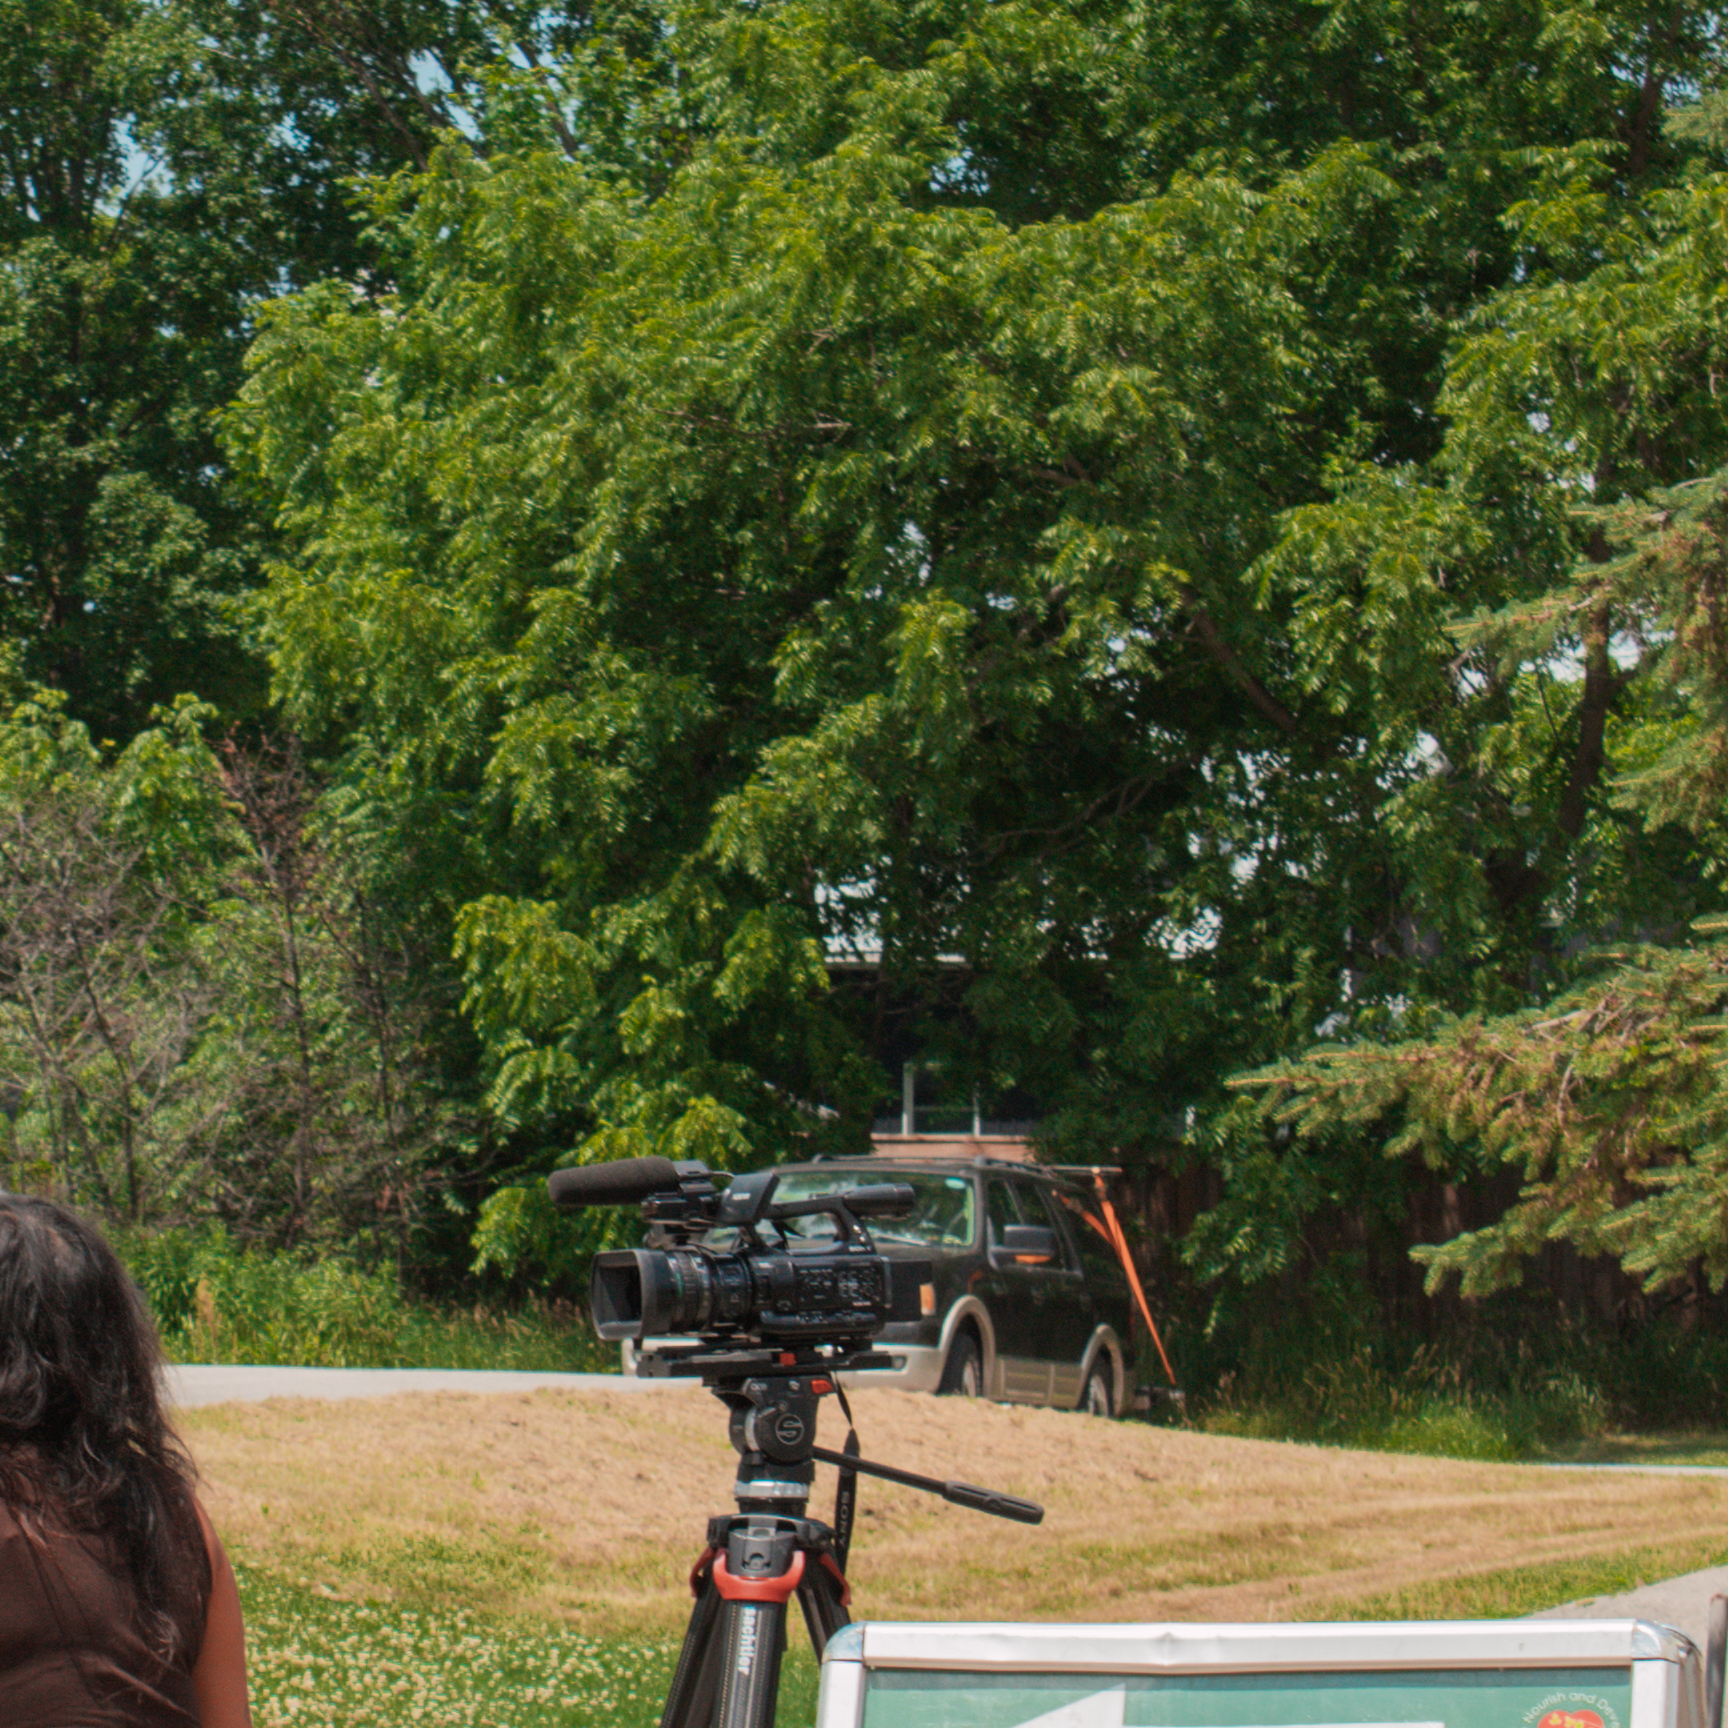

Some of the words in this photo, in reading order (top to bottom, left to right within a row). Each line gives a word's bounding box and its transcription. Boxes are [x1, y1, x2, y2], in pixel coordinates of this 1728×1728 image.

[840, 1491, 851, 1544] SONY
[737, 1605, 757, 1676] sachtler
[1522, 1692, 1566, 1723] Nourish
[1568, 1692, 1597, 1704] and
